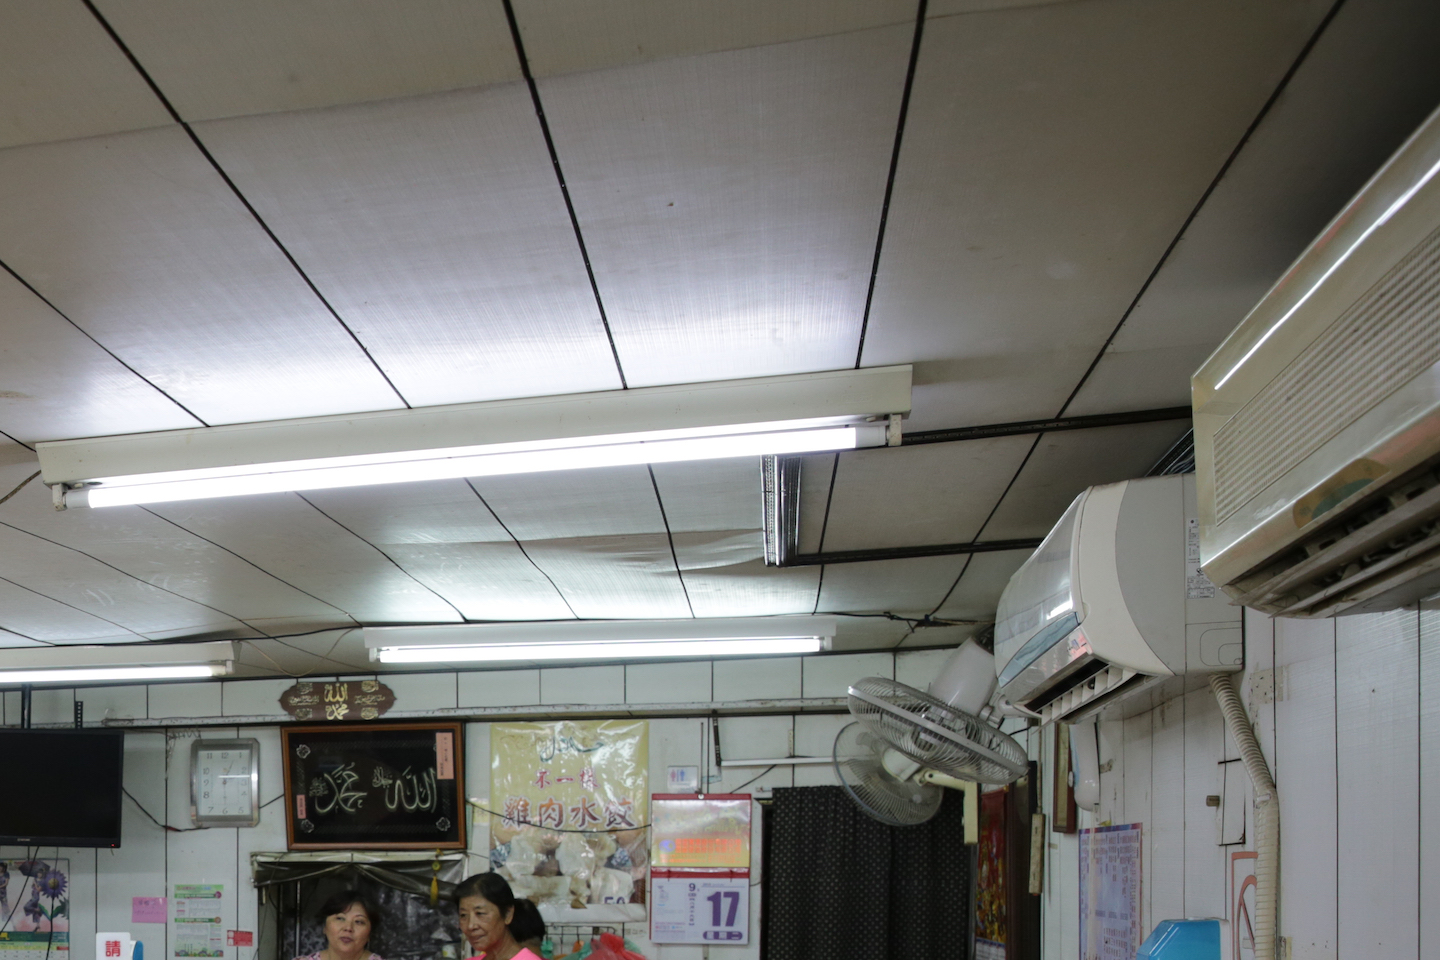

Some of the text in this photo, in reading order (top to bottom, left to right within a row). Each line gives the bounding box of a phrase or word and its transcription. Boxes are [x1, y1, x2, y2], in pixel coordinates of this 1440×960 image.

[503, 796, 636, 829] 雞肉水餃
[688, 883, 696, 892] 9
[706, 891, 740, 927] 17
